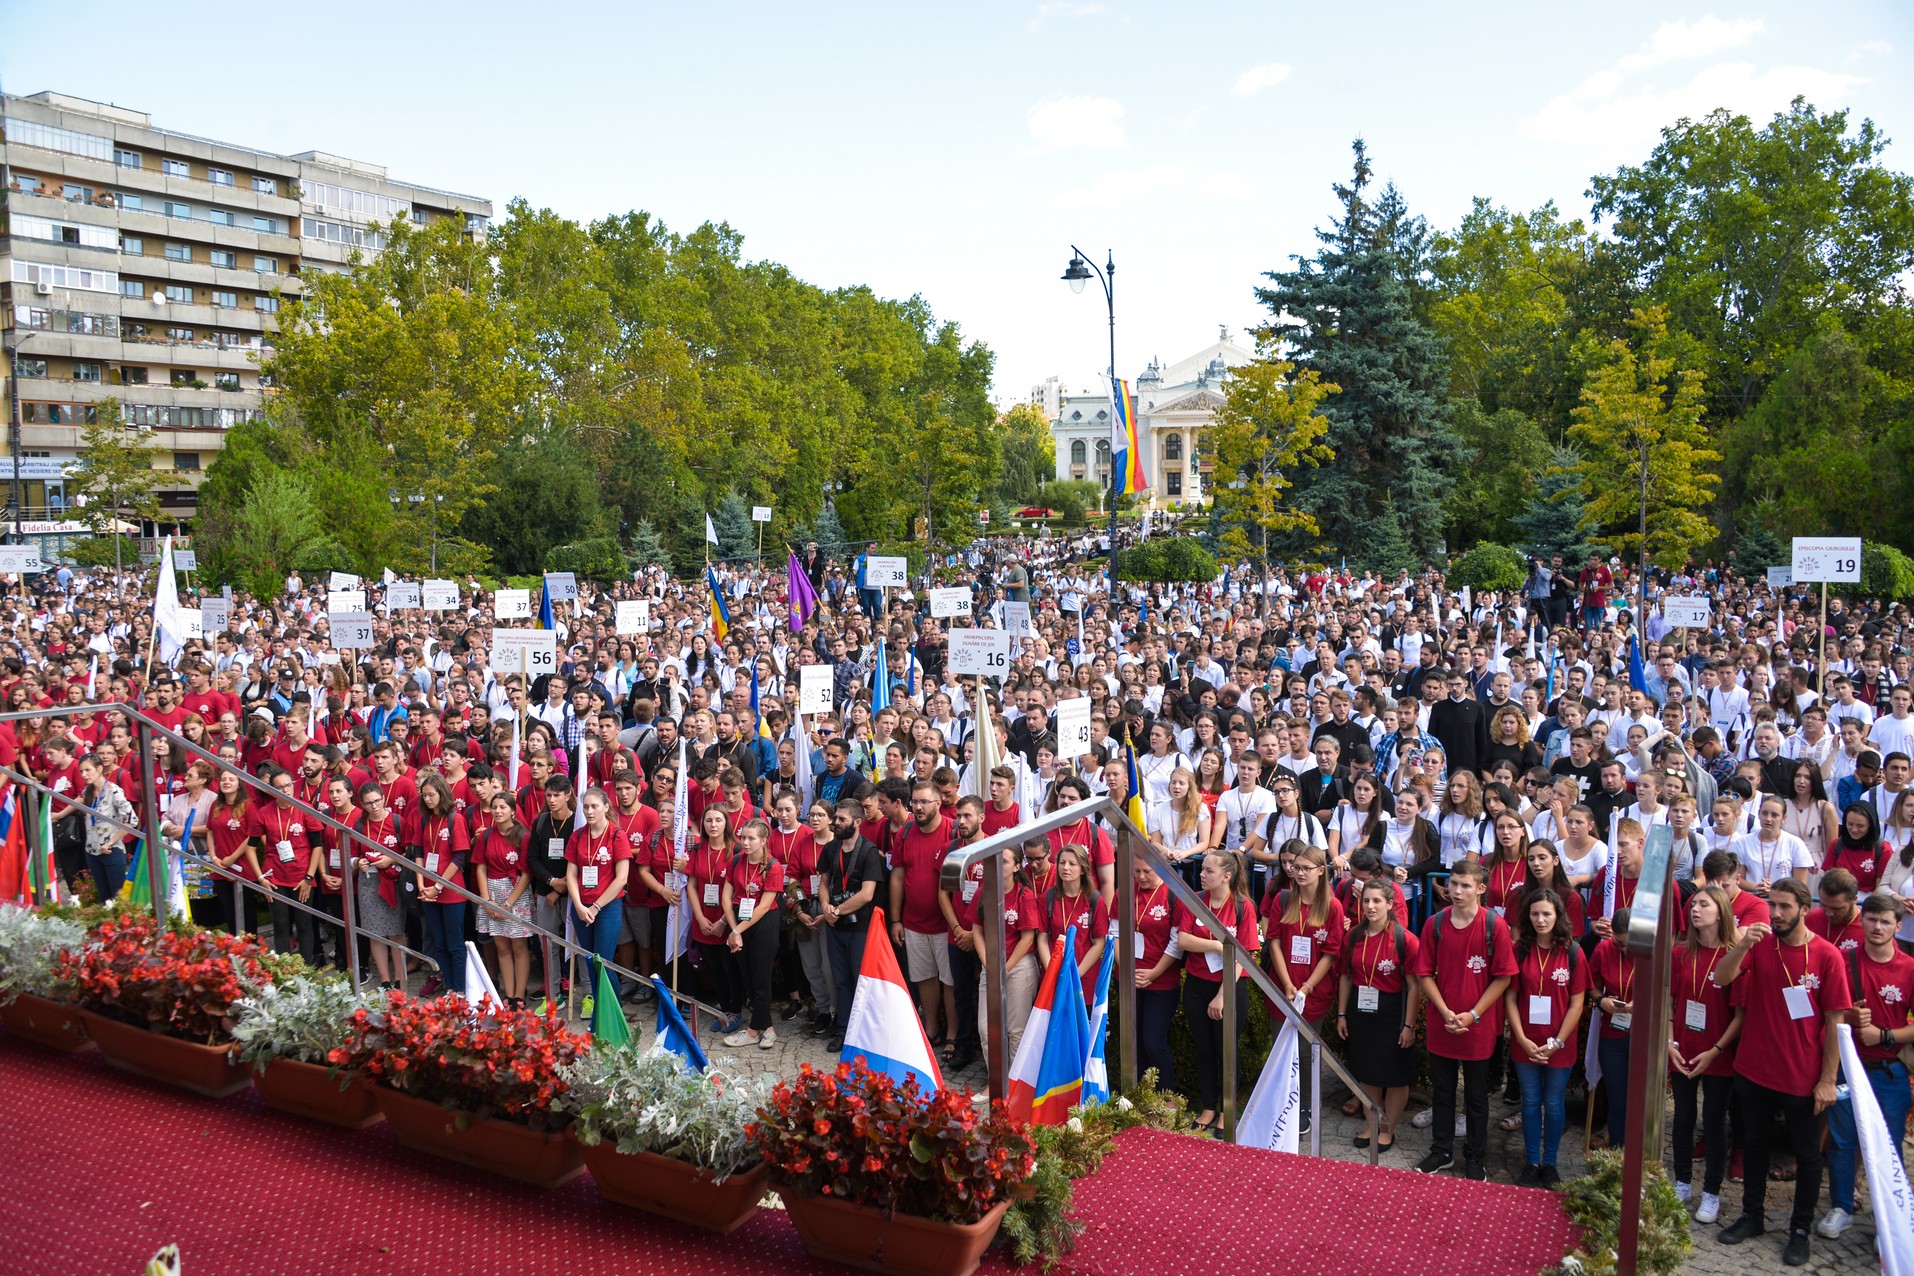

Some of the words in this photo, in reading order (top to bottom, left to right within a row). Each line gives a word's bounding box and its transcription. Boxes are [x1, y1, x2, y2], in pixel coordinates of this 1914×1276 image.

[22, 524, 51, 532] Fidelia
[26, 558, 38, 567] 55
[1836, 560, 1856, 572] 19
[892, 572, 904, 580] 38
[566, 586, 575, 594] 50
[408, 595, 417, 603] 34
[446, 596, 456, 604] 34
[516, 602, 526, 612] 37
[956, 601, 968, 610] 38
[638, 616, 646, 626] 11
[1692, 612, 1706, 621] 17
[191, 623, 200, 632] 34
[1020, 620, 1029, 630] 48
[356, 628, 370, 640] 37
[532, 651, 551, 664] 56
[986, 652, 1004, 666] 16
[821, 689, 831, 702] 52
[1078, 726, 1088, 742] 43
